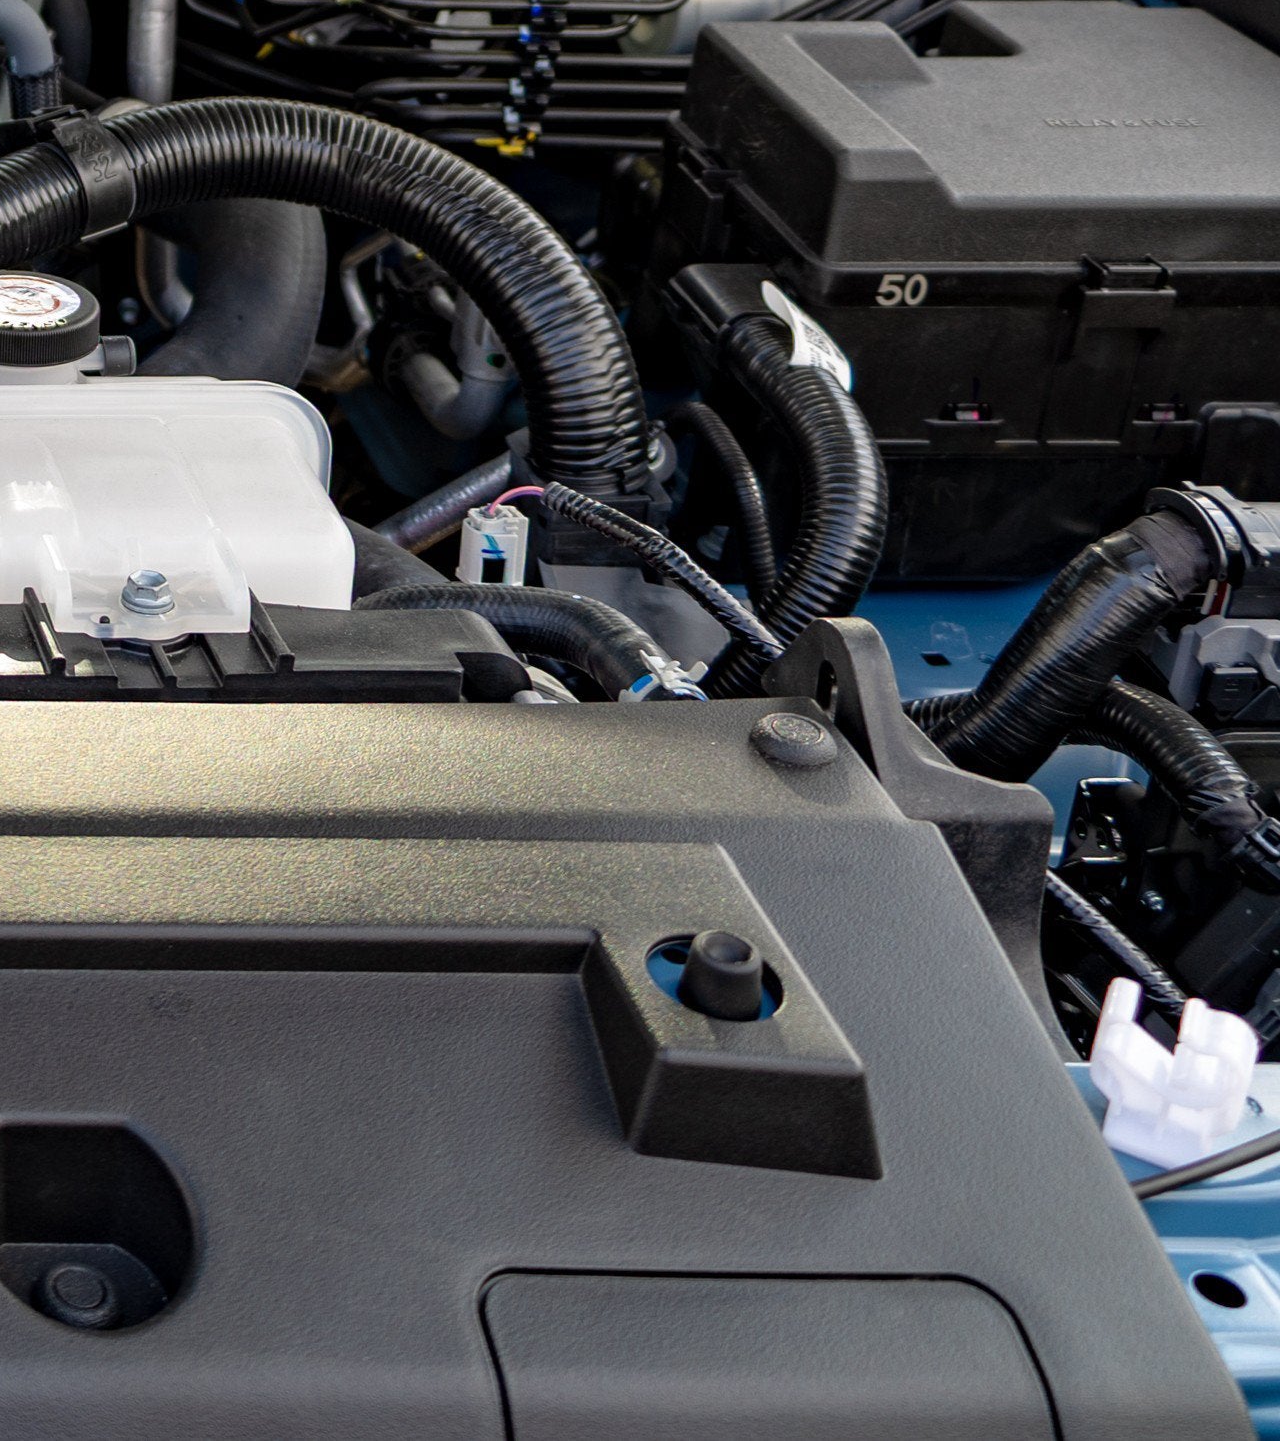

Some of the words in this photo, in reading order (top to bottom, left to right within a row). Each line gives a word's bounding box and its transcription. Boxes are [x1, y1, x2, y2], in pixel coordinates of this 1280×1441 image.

[1043, 118, 1117, 127] RELAY
[1140, 118, 1207, 128] FUSE
[85, 152, 118, 183] 32
[875, 273, 929, 306] 50
[0, 317, 68, 332] DENSO
